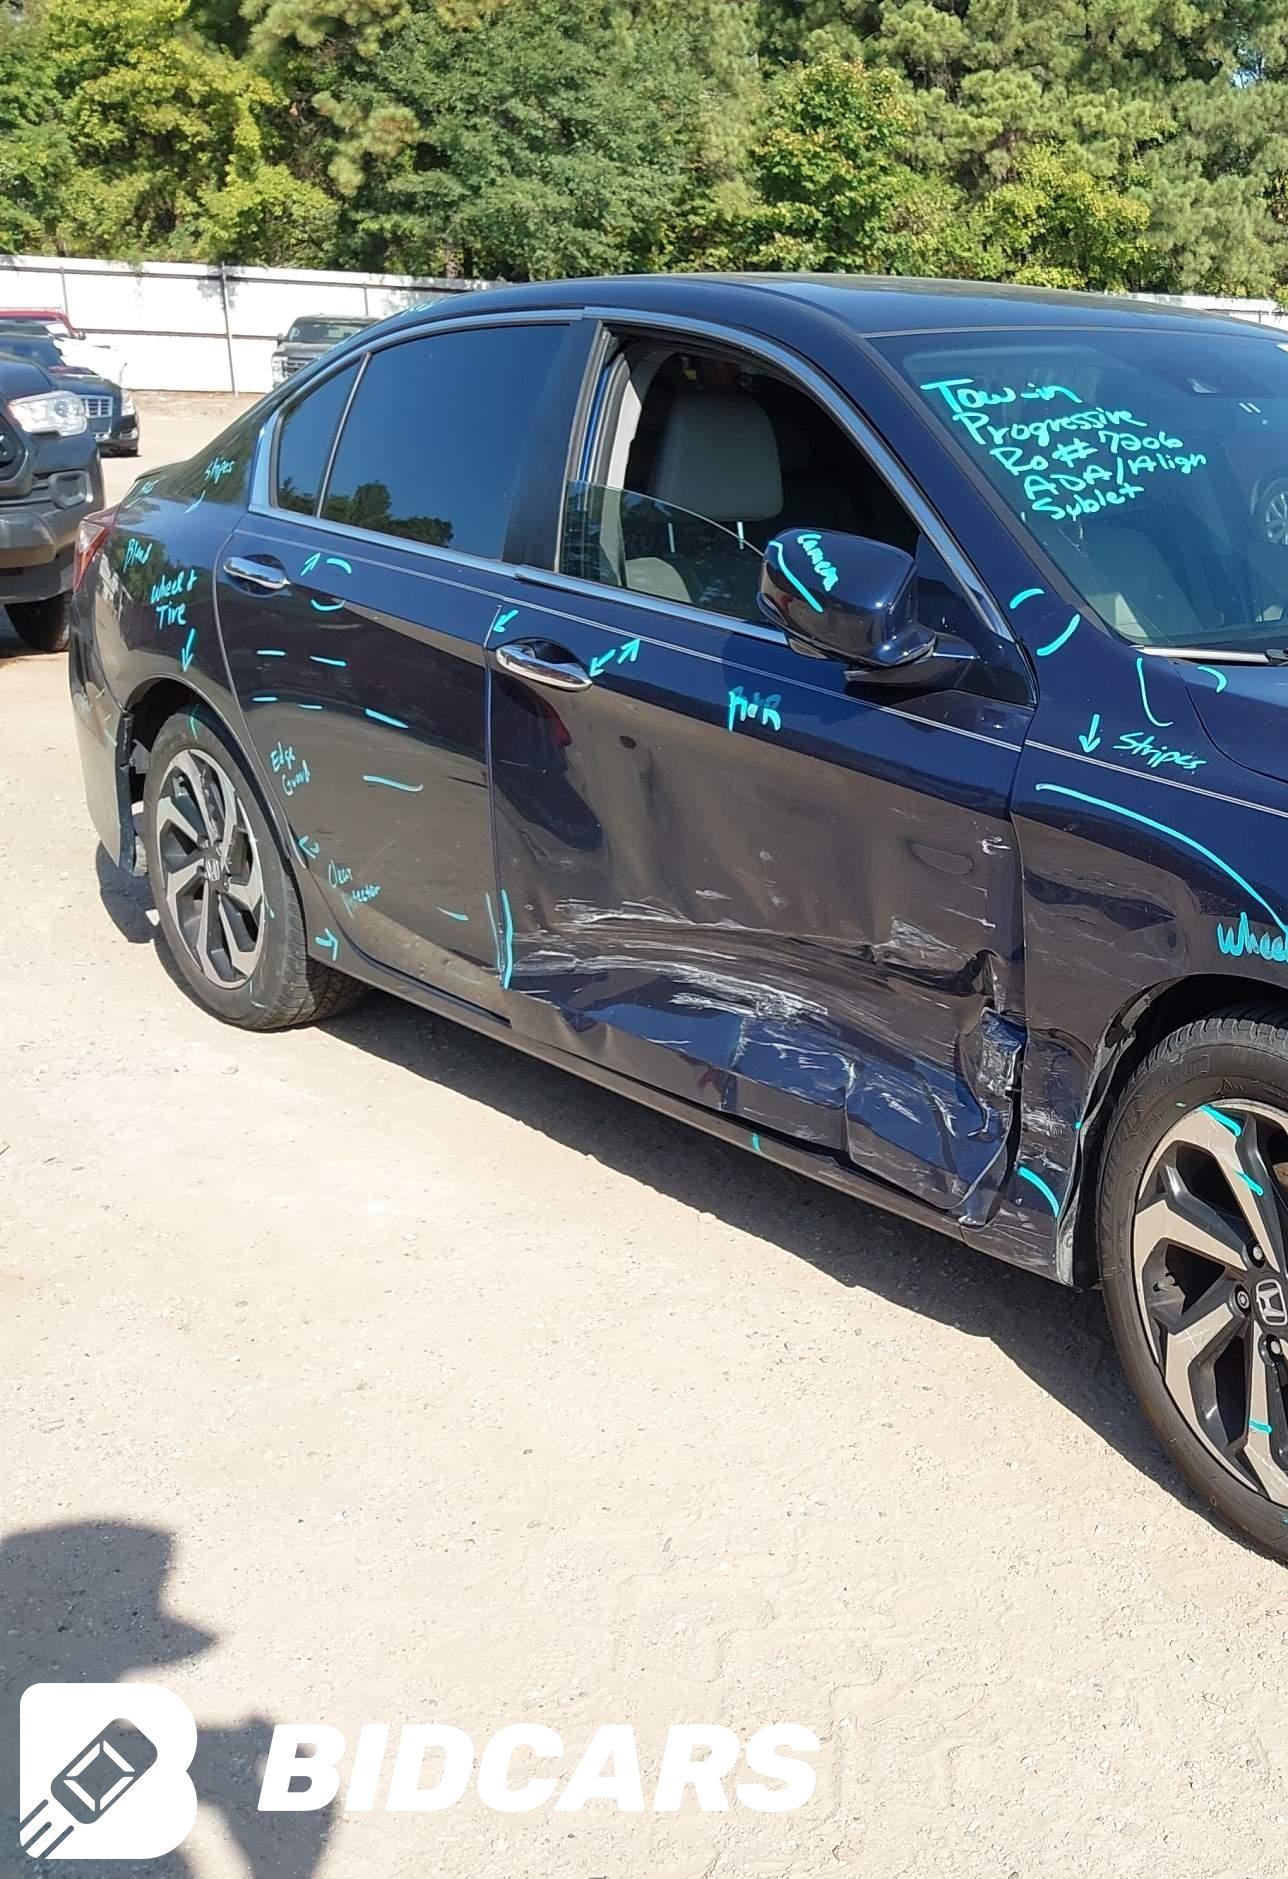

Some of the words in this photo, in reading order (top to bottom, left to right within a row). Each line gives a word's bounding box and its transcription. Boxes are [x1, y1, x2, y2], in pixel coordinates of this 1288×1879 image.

[952, 407, 1147, 448] Progressive
[1031, 483, 1145, 522] Sublet
[156, 600, 187, 630] Tire
